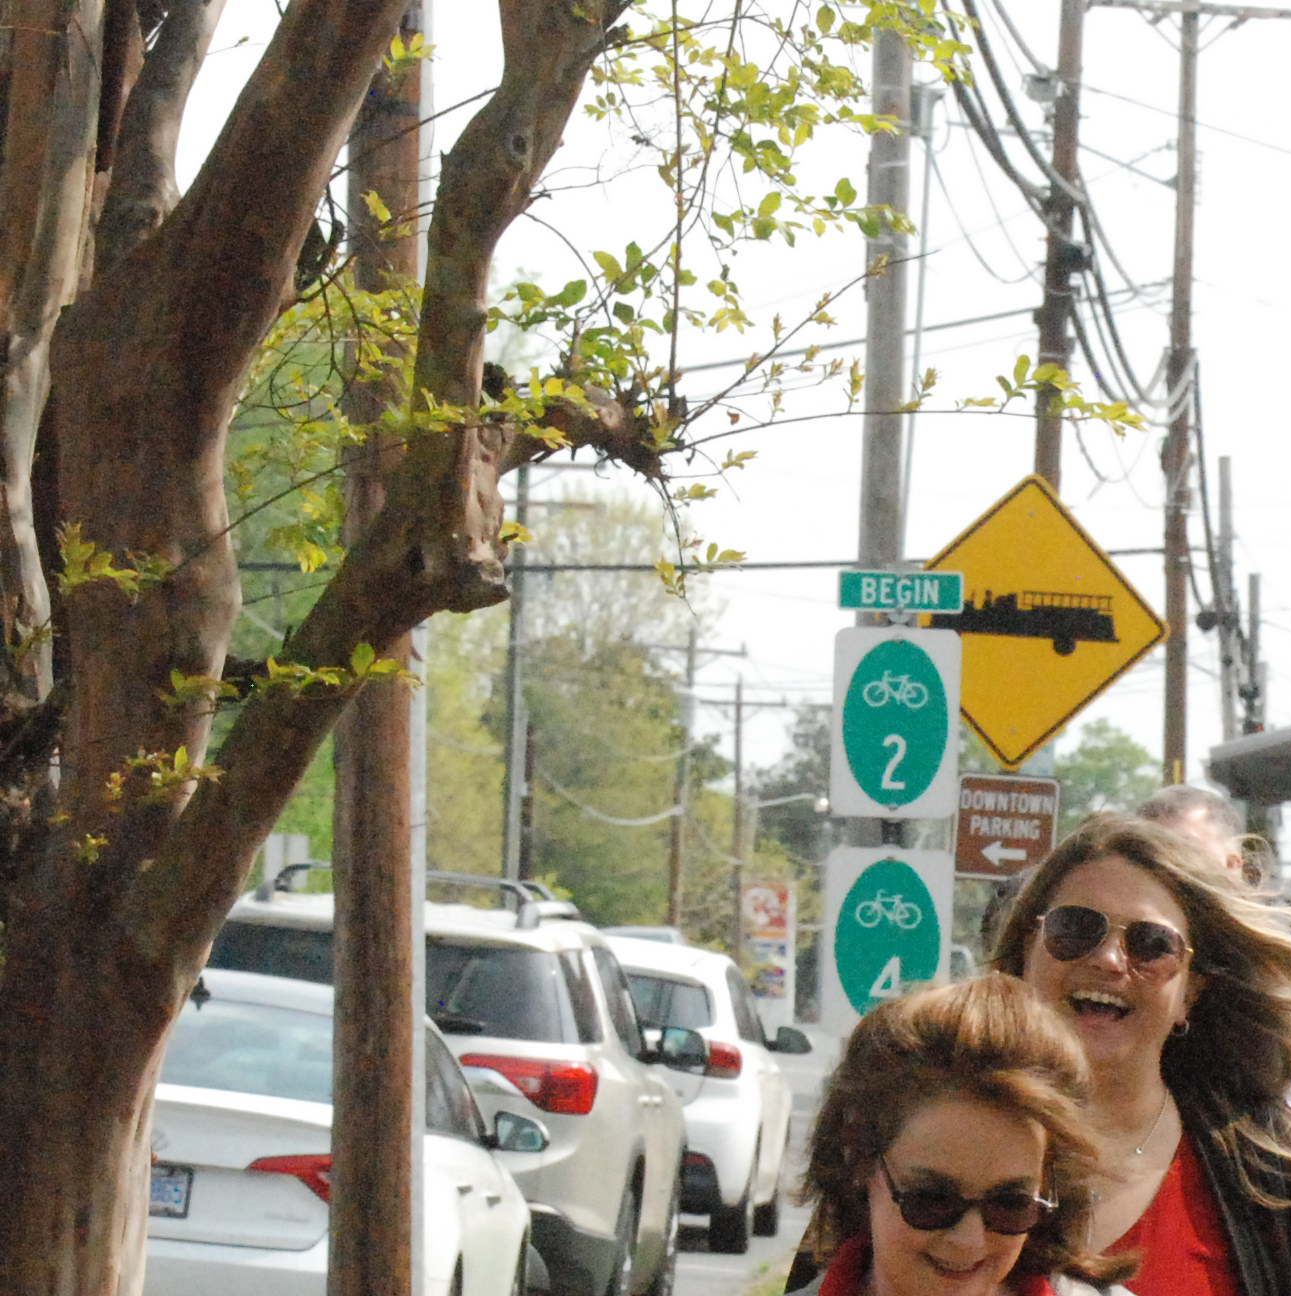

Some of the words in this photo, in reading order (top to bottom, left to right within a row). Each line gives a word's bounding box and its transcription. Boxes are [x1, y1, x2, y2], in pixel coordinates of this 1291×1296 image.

[861, 577, 940, 605] BEGIN
[881, 733, 907, 790] 2
[960, 788, 1056, 814] DOWNTOWN
[970, 814, 1041, 840] PARKING
[868, 954, 902, 1000] 4
